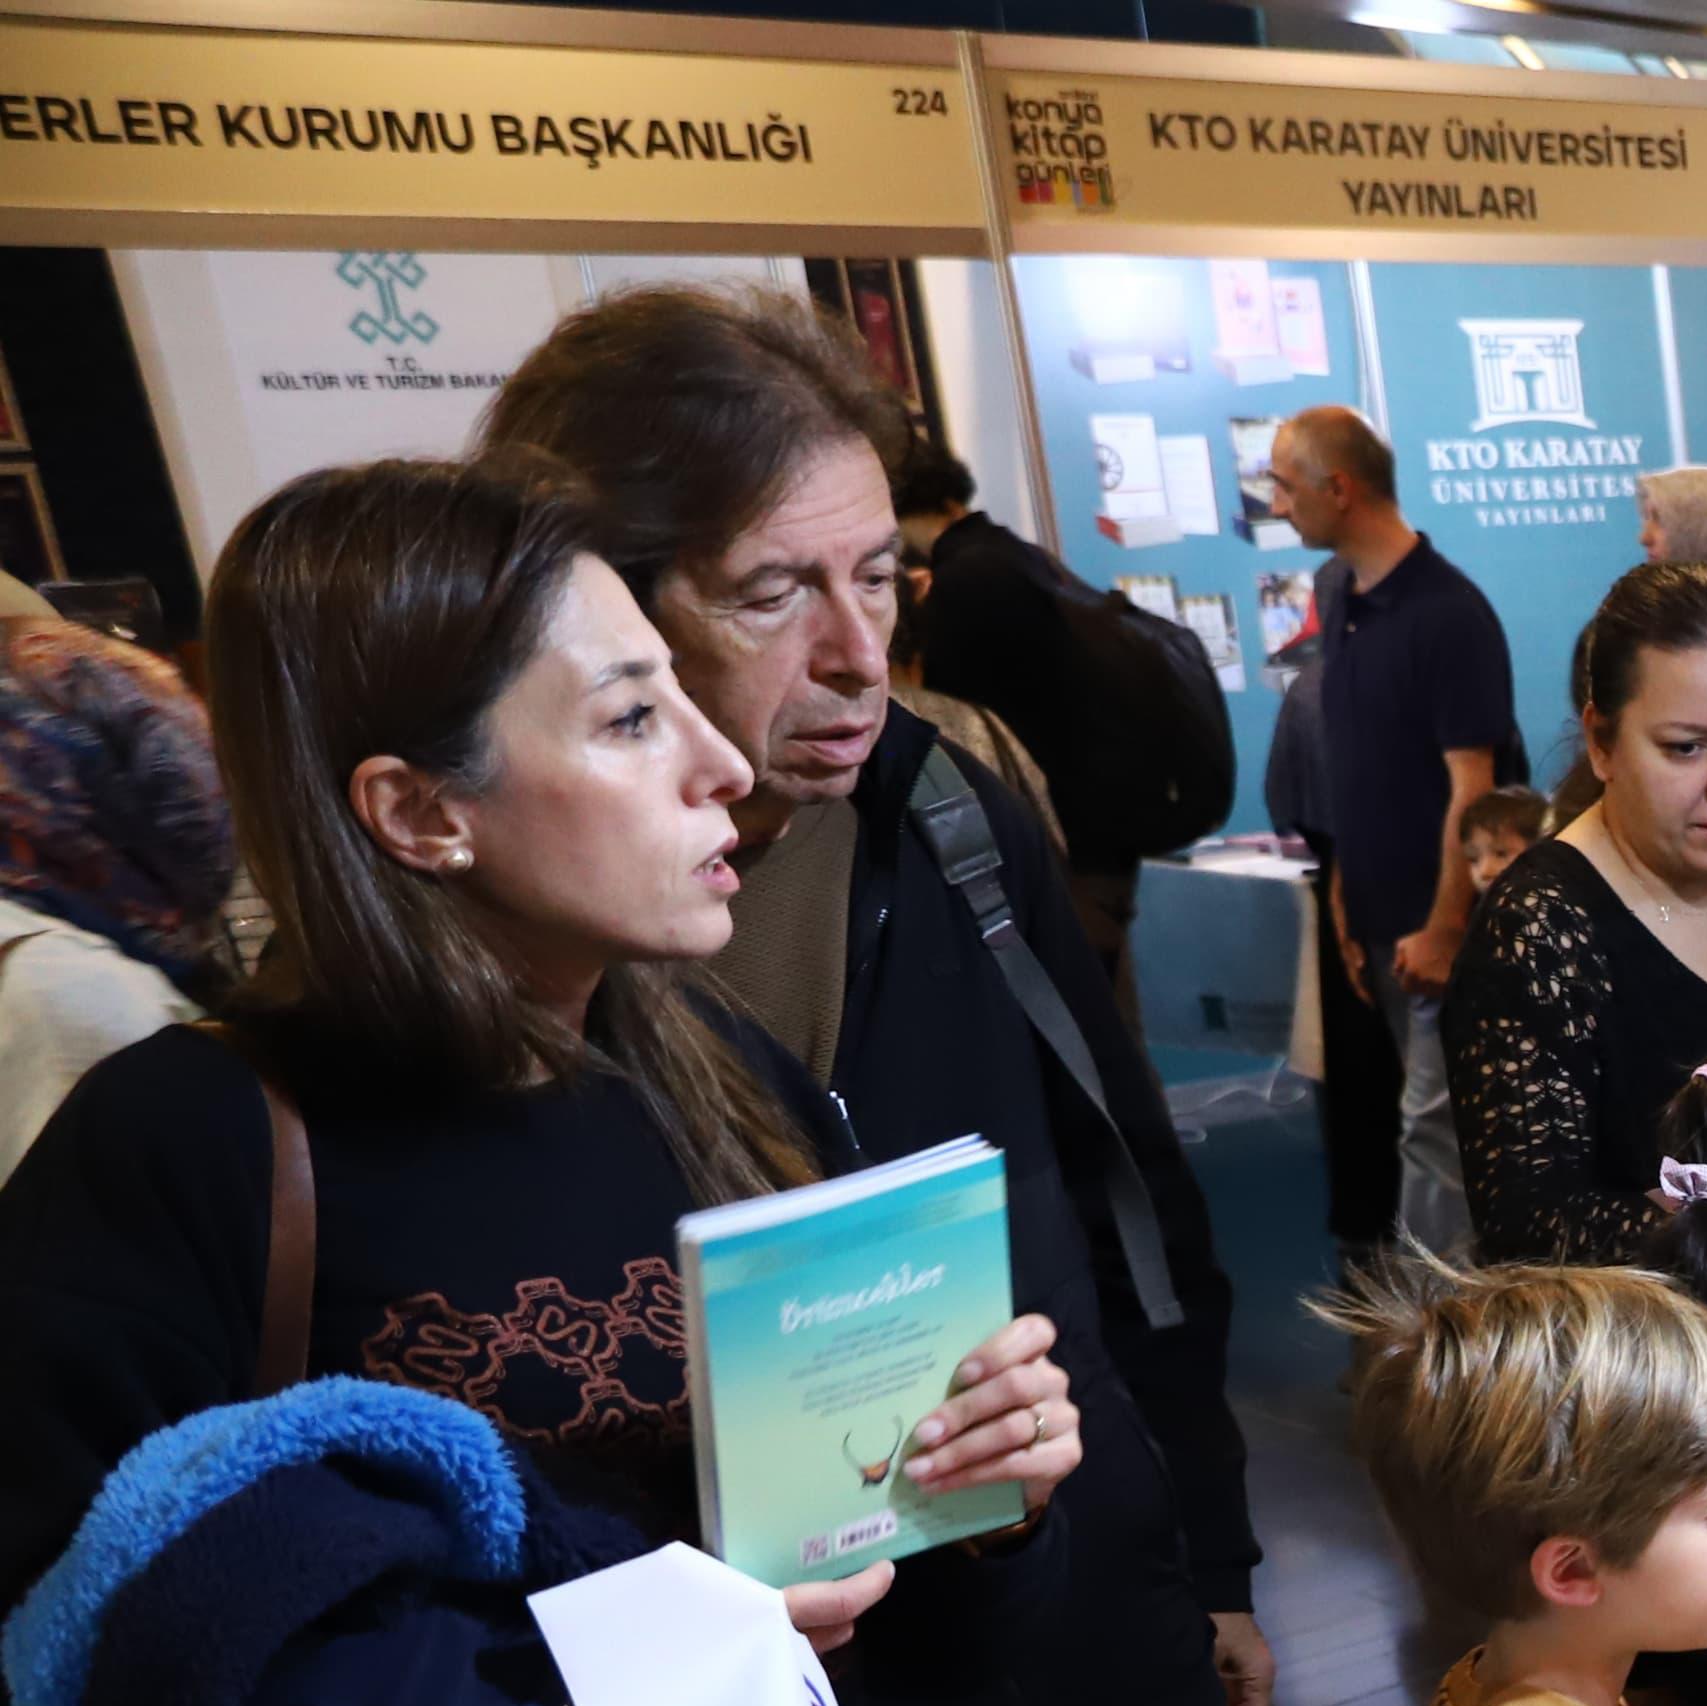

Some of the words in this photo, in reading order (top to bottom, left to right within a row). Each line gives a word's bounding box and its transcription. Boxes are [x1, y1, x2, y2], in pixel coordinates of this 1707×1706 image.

[892, 87, 948, 119] 224
[1005, 91, 1104, 131] konya
[216, 103, 473, 155] KURUMU
[492, 111, 814, 169] BAŞKANLIĞI
[1010, 122, 1107, 165] kitap
[1148, 112, 1238, 154] KTO
[1248, 117, 1432, 163] KARATAY
[1443, 117, 1690, 172] ÜNİVERSİTESİ
[1341, 180, 1539, 223] YAYINLARI
[261, 371, 341, 391] KÜLTÜR
[345, 373, 369, 390] VE
[375, 373, 447, 391] TURİZM
[1426, 439, 1499, 472] KTO
[1502, 436, 1643, 469] KARATAY
[1430, 471, 1638, 506] ÜNİVERSİTES
[1475, 503, 1607, 529] YAYINLARI
